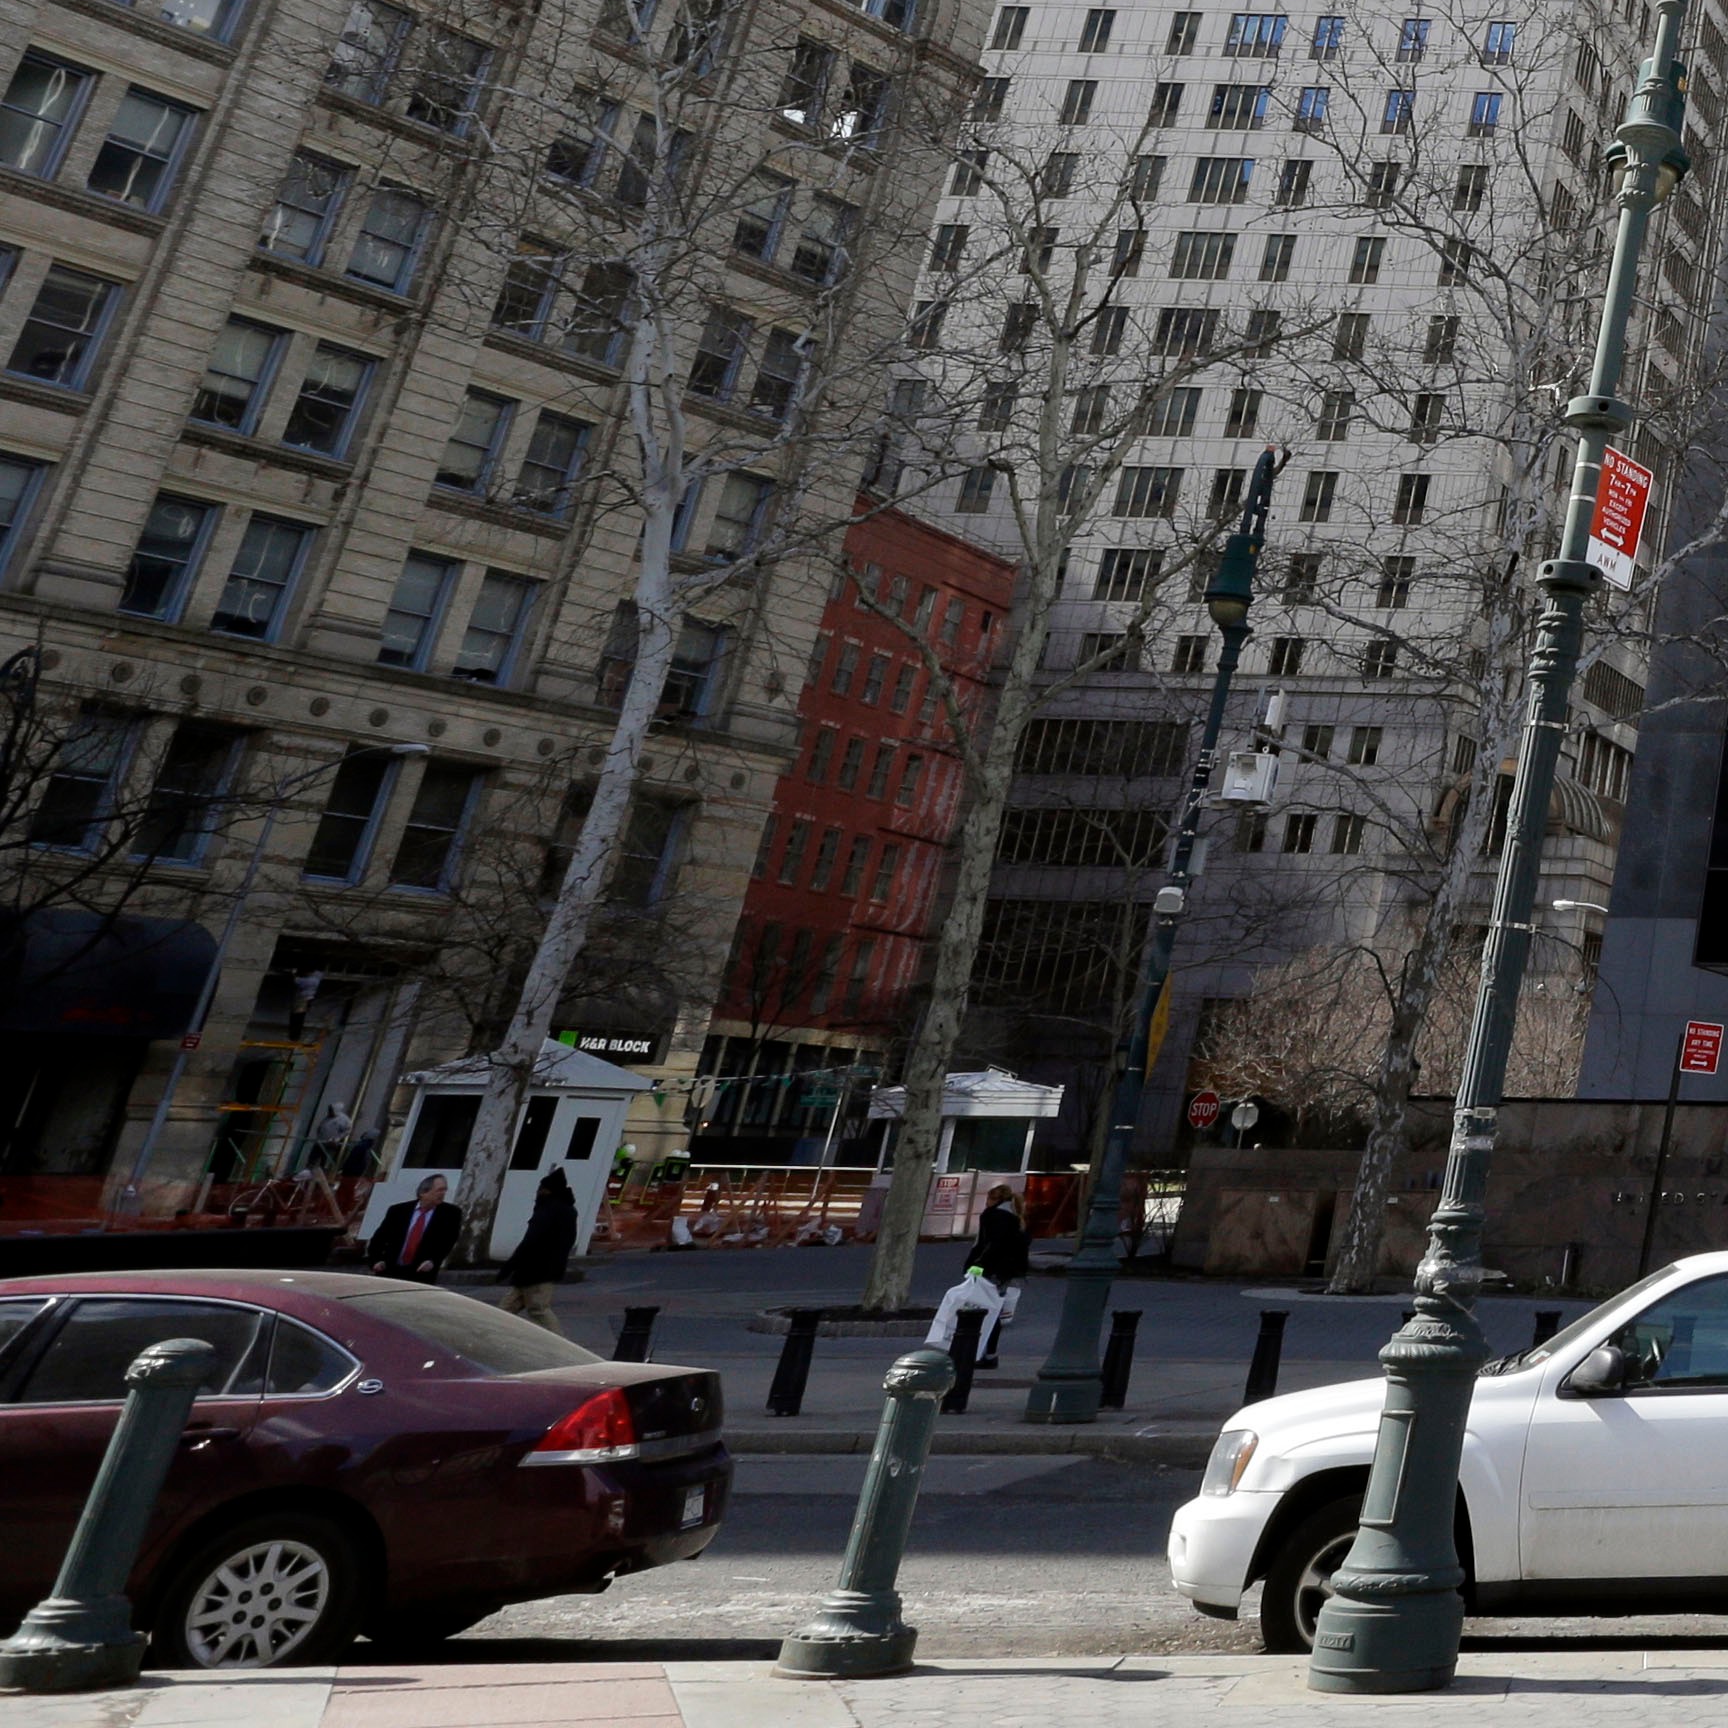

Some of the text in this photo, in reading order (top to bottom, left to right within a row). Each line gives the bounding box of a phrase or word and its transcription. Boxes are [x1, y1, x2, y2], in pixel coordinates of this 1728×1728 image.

[1604, 453, 1648, 488] NO STANDING
[1609, 500, 1628, 514] EXCEPT
[580, 1037, 651, 1053] H&R BLOCK
[1191, 1102, 1218, 1117] STOP
[1612, 1191, 1685, 1206] UNIED
